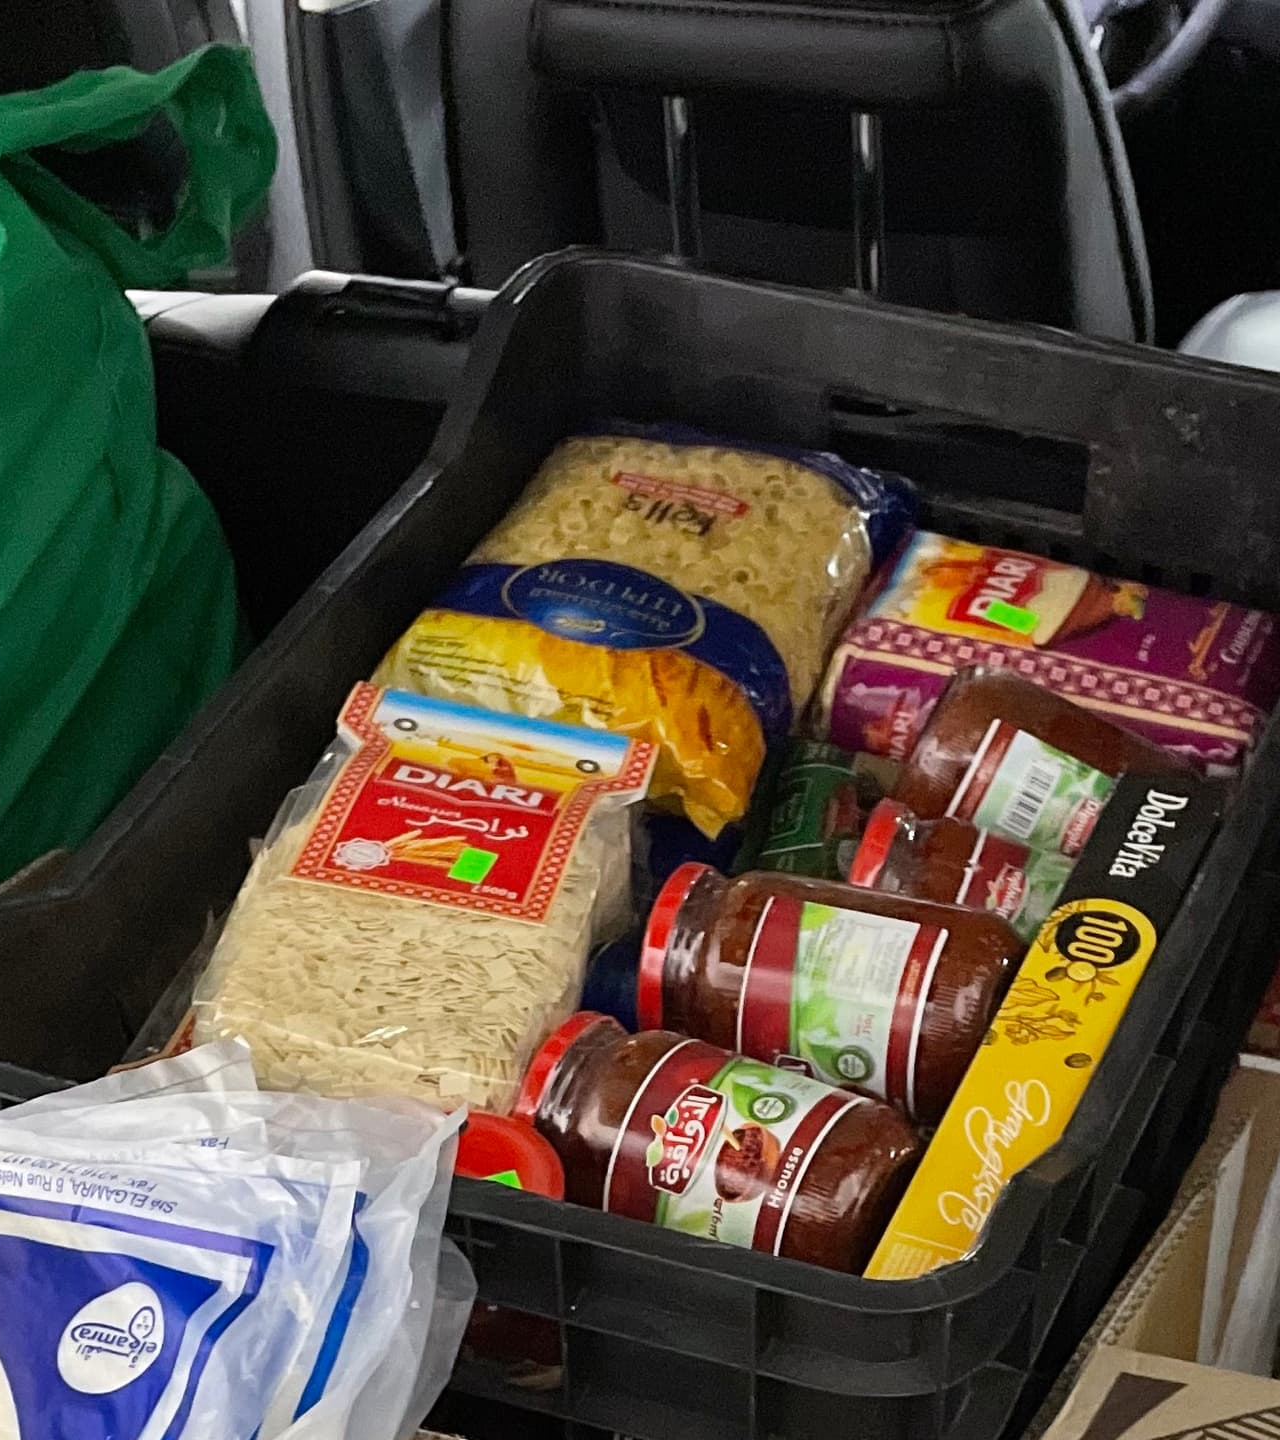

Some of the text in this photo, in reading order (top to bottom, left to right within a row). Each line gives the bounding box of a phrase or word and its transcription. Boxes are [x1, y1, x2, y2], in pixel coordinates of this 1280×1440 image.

[393, 764, 544, 809] DIARI
[405, 814, 530, 841] نواصر
[1108, 789, 1190, 881] DolceVita
[1075, 915, 1128, 964] 100
[27, 1173, 53, 1192] Rue
[767, 1147, 805, 1210] Hrousse
[78, 1306, 157, 1354] elgamra
